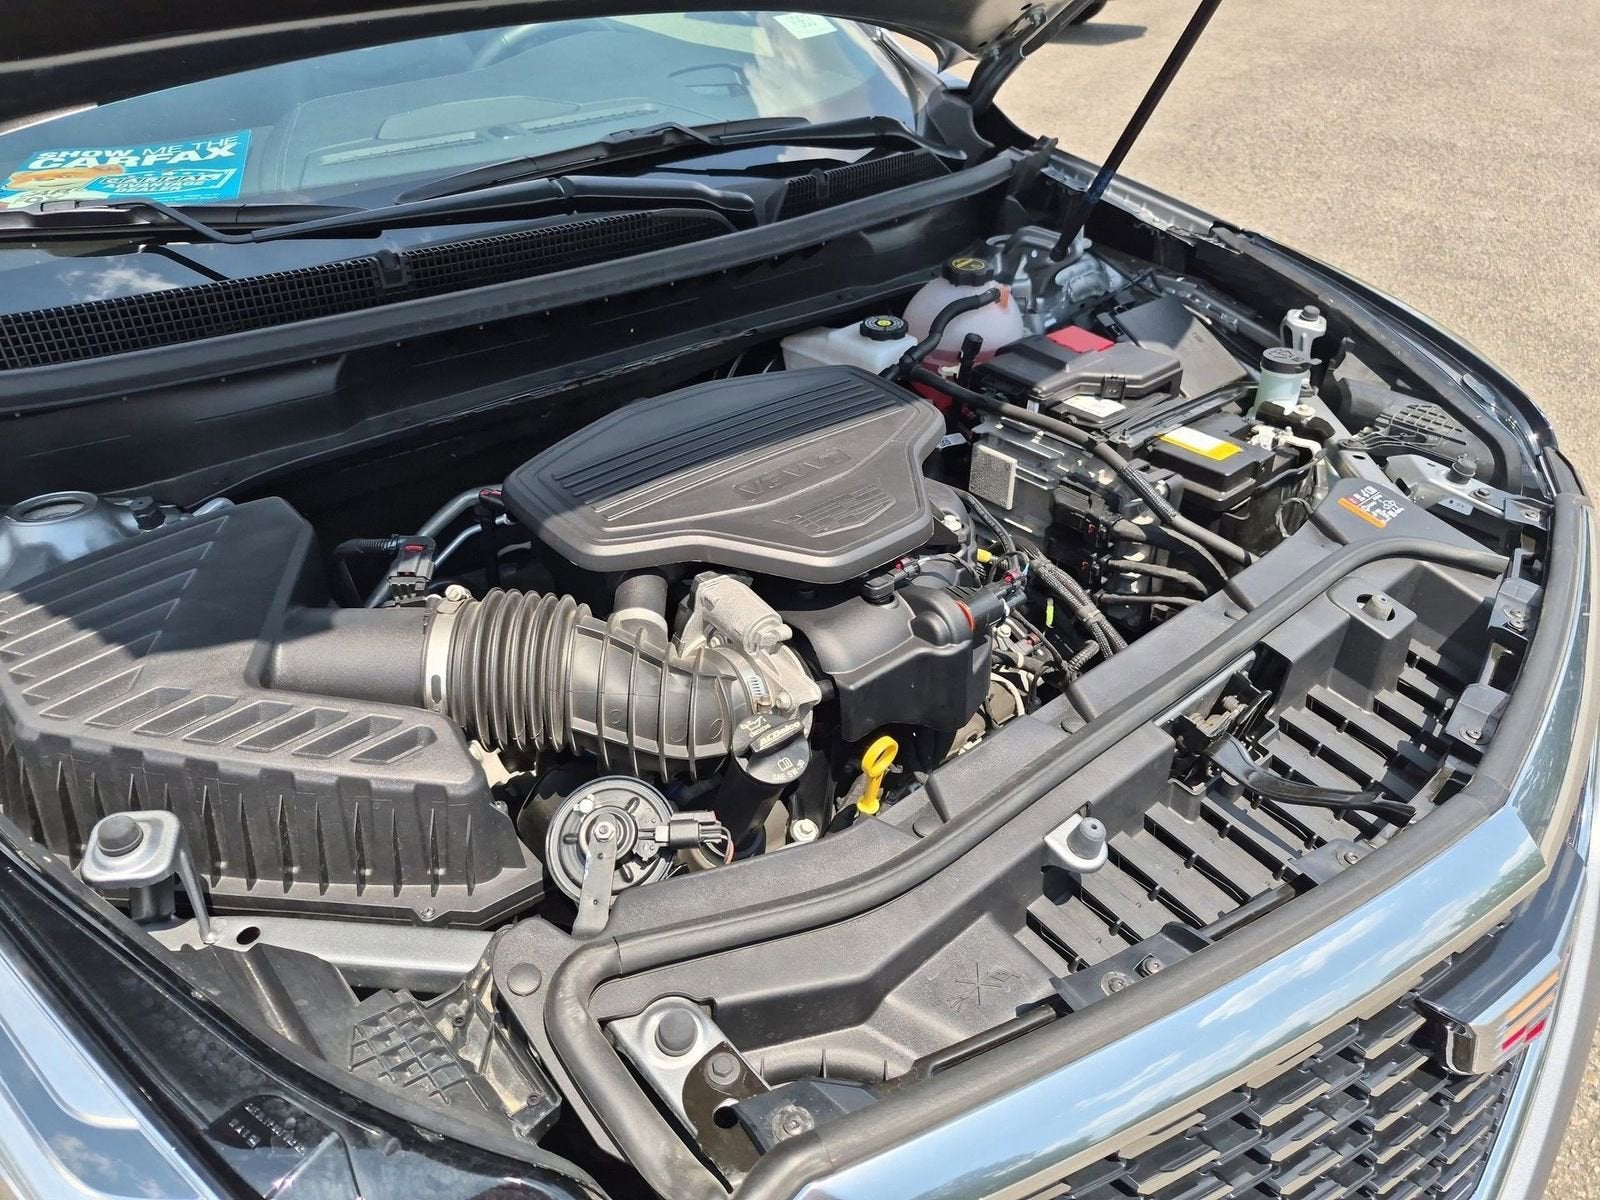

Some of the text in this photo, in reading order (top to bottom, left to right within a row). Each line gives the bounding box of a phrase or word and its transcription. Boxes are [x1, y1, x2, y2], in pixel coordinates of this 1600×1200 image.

[28, 143, 237, 170] CARFAX
[38, 135, 239, 160] SHOW ME THE
